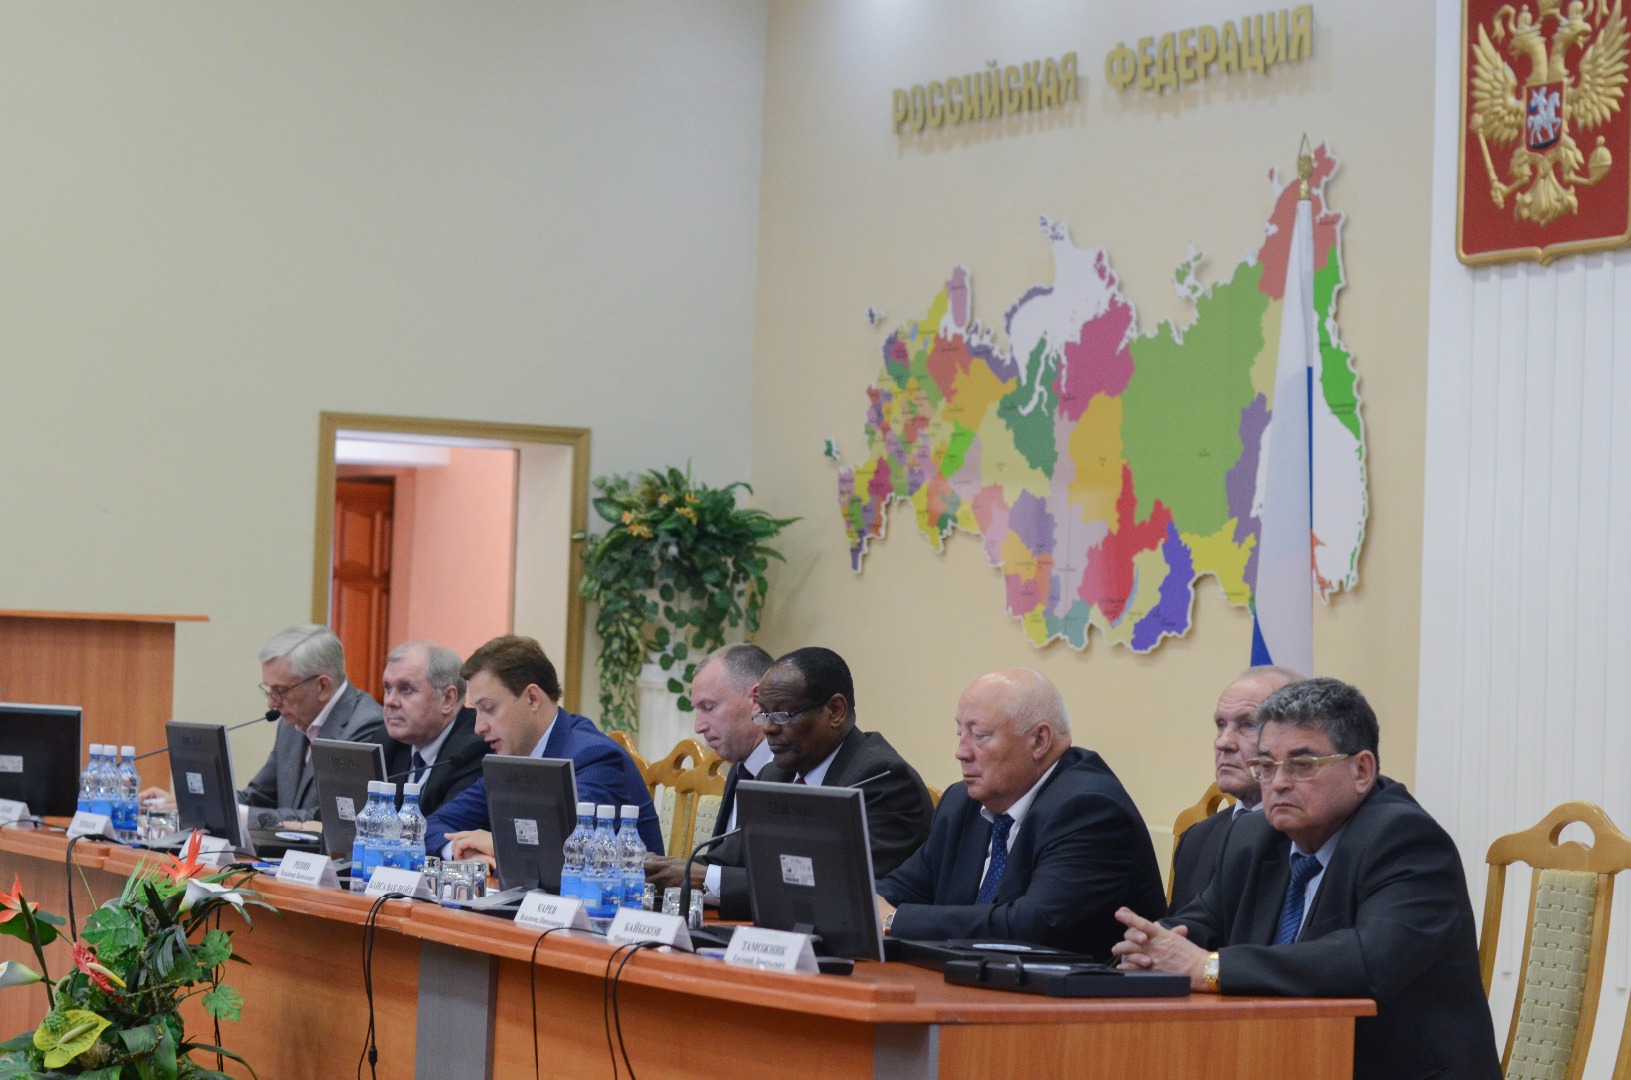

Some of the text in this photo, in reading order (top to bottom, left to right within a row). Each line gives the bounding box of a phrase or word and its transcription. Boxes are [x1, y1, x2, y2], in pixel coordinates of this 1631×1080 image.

[893, 5, 1313, 134] РОССИЙСКАЯ ФЕДЕРАЦИЯ
[624, 921, 662, 937] БАЙБЕКОВ
[742, 941, 788, 956] ТАМОЖНИК
